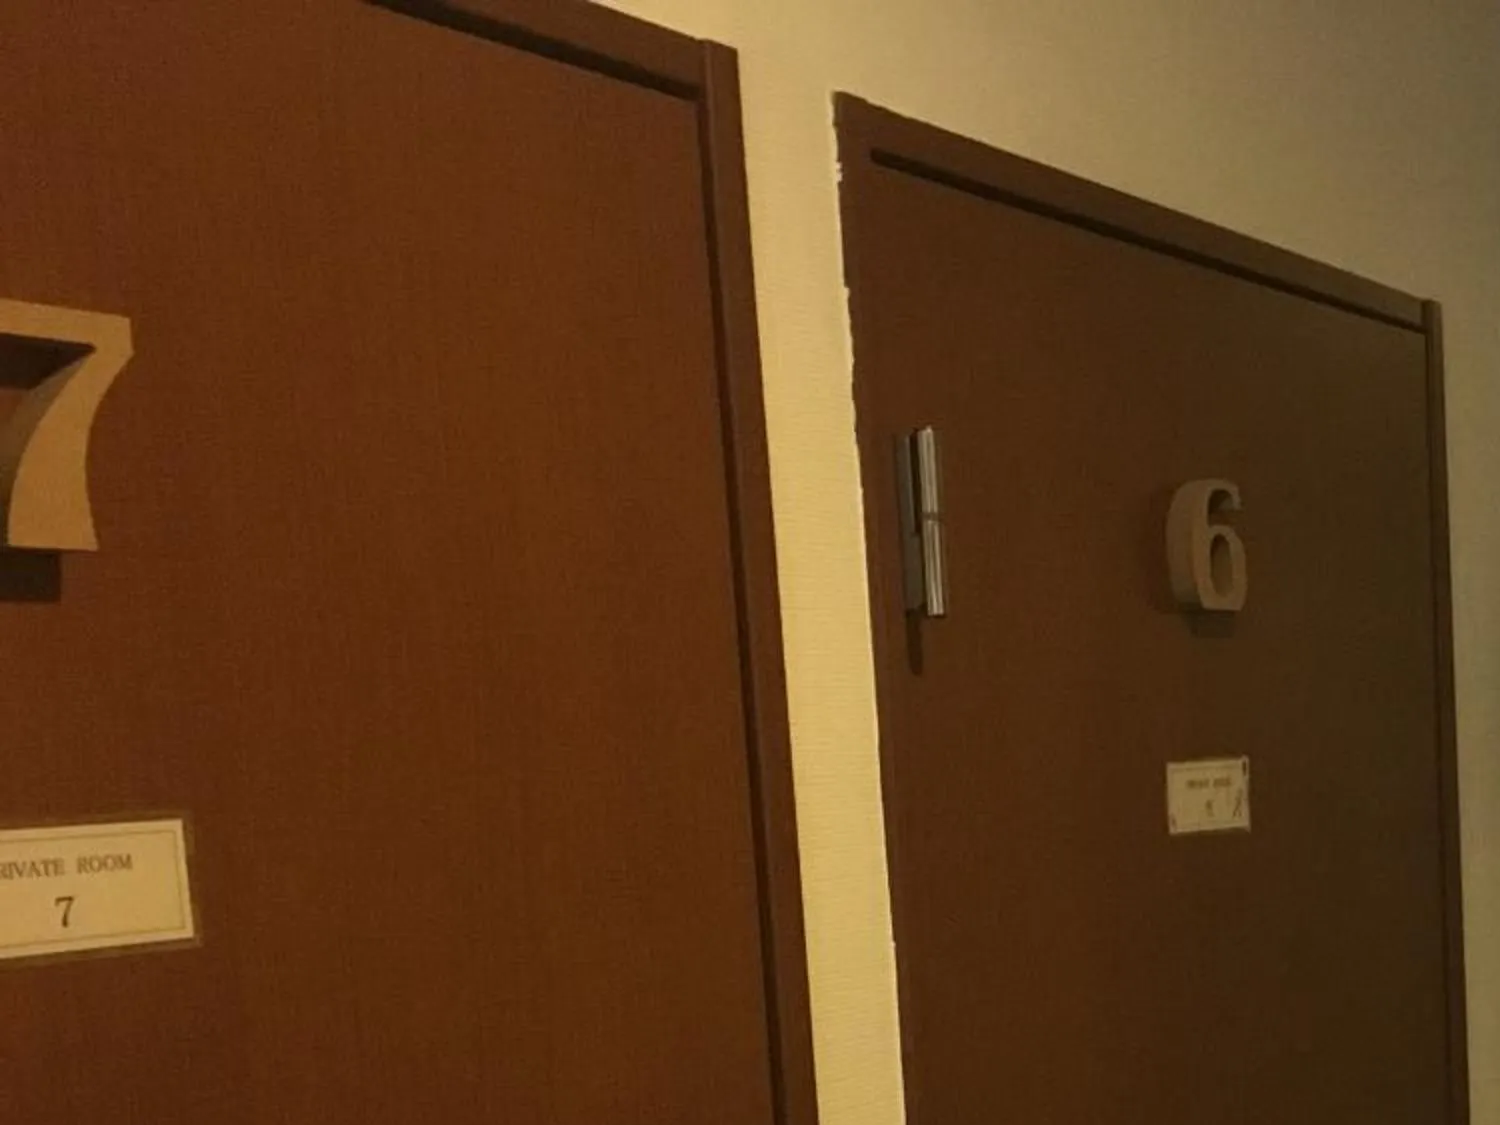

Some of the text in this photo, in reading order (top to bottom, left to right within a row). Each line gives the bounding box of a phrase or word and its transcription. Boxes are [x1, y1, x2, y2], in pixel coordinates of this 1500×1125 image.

[0, 298, 133, 551] 7
[1185, 477, 1249, 612] 6
[76, 853, 133, 875] ROOM
[54, 895, 76, 928] 7
